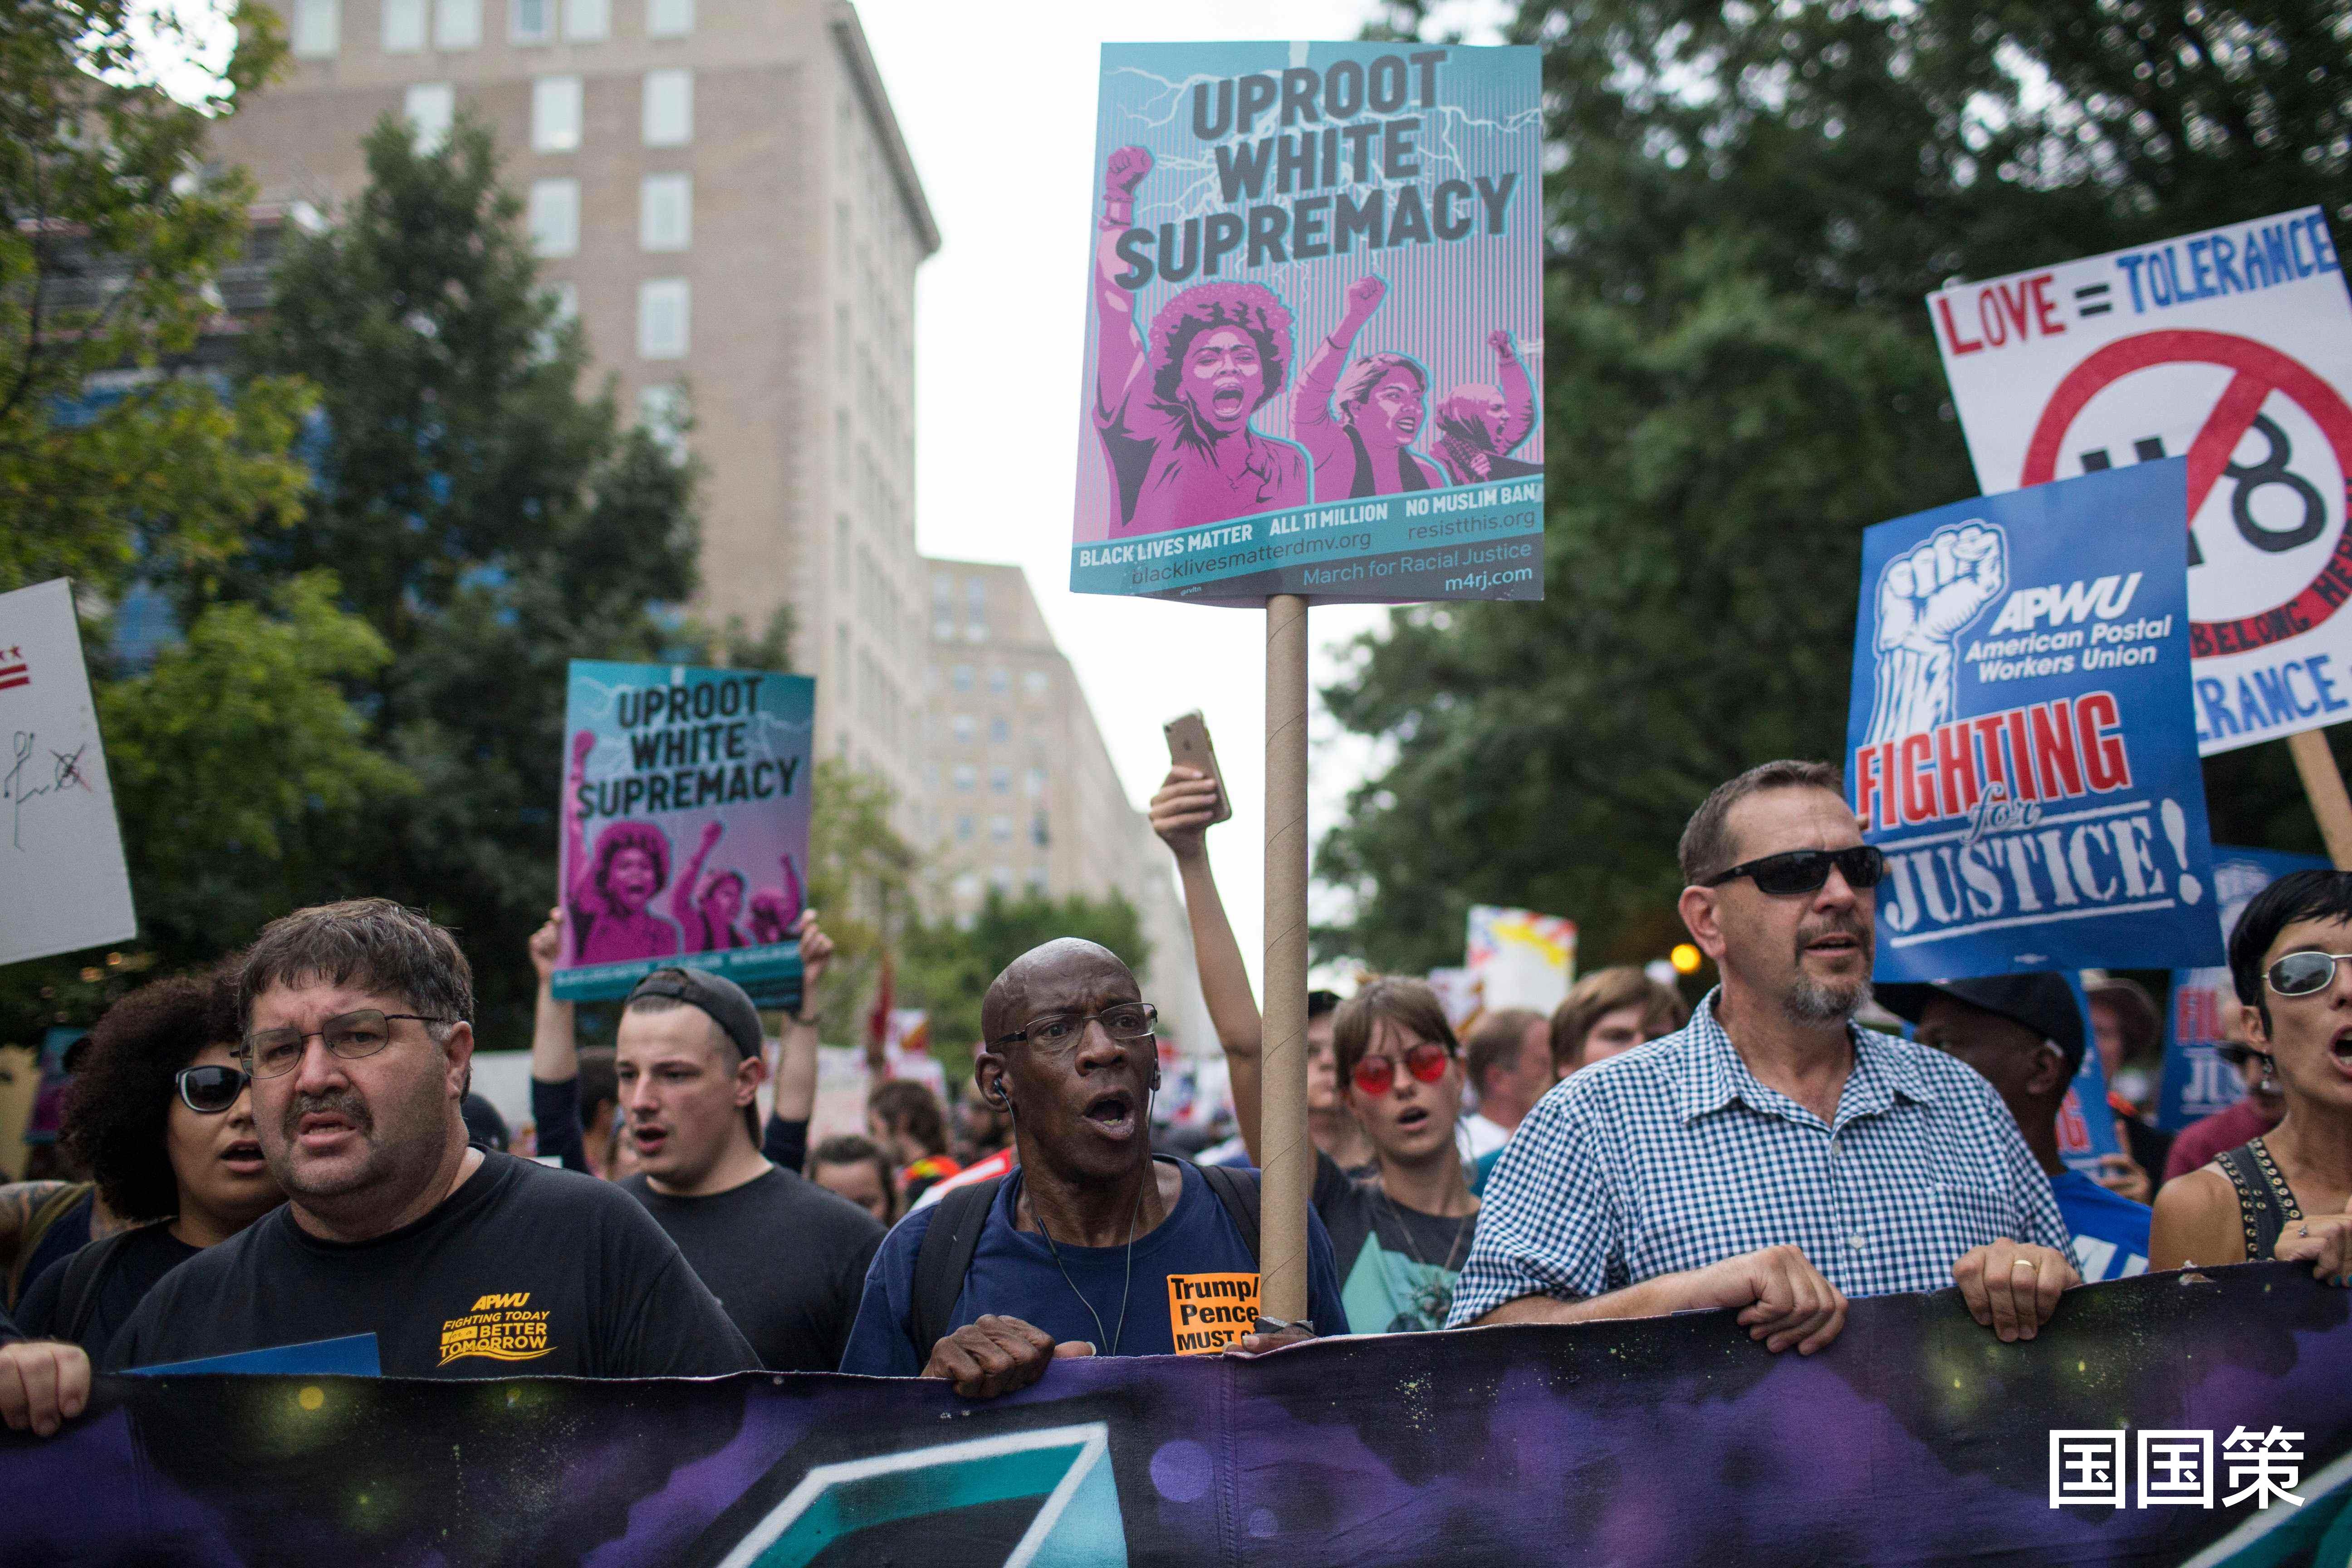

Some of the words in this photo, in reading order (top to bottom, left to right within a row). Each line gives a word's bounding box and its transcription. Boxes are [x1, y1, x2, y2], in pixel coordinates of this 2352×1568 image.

[1192, 50, 1447, 140] UPROOT
[1215, 119, 1420, 203] WHITE
[1113, 172, 1519, 290] SUPREMACY
[1937, 274, 2066, 356] LOVE
[2116, 214, 2341, 315] TOLERANCE
[1269, 515, 1300, 536] ALL
[1303, 512, 1316, 530] 11
[1320, 503, 1388, 528] MILLION
[1406, 498, 1429, 517] NO
[1433, 488, 1498, 514] MUSLIM
[1500, 483, 1535, 504] BAN
[1080, 544, 1134, 567] BLACK
[1137, 536, 1184, 561] LIVES
[1188, 524, 1253, 552] MATTER
[1408, 511, 1535, 539] resistthis.org
[1132, 533, 1371, 584] blacklivesmatterdmv.org
[1303, 563, 1364, 586] March
[1369, 560, 1398, 577] for
[1401, 550, 1459, 573] Racial
[1462, 543, 1532, 565] Justice
[1446, 567, 1533, 591] m4rj.com
[1989, 572, 2143, 636] APWU
[1964, 630, 2084, 663] American
[2090, 614, 2172, 646] Postal
[2190, 602, 2312, 658] BELONG
[1978, 654, 2075, 683] Workers
[2081, 645, 2157, 671] Union
[617, 676, 764, 728] UPROOT
[2197, 655, 2349, 741] RANCE
[631, 722, 747, 770] WHITE
[1856, 691, 2132, 833] FIGHTING
[576, 757, 799, 819] SUPREMACY
[1959, 780, 2041, 844] for
[1884, 798, 2203, 932] JUSTICE!
[471, 1293, 530, 1311] APWU
[1171, 1277, 1259, 1302] Trump/
[443, 1313, 502, 1330] FIGHTING
[505, 1311, 550, 1321] TODAY
[448, 1331, 462, 1343] for
[480, 1323, 547, 1338] BETTER
[1181, 1304, 1259, 1326] Pence
[440, 1336, 547, 1357] TOMORROW
[1176, 1330, 1235, 1351] MUST
